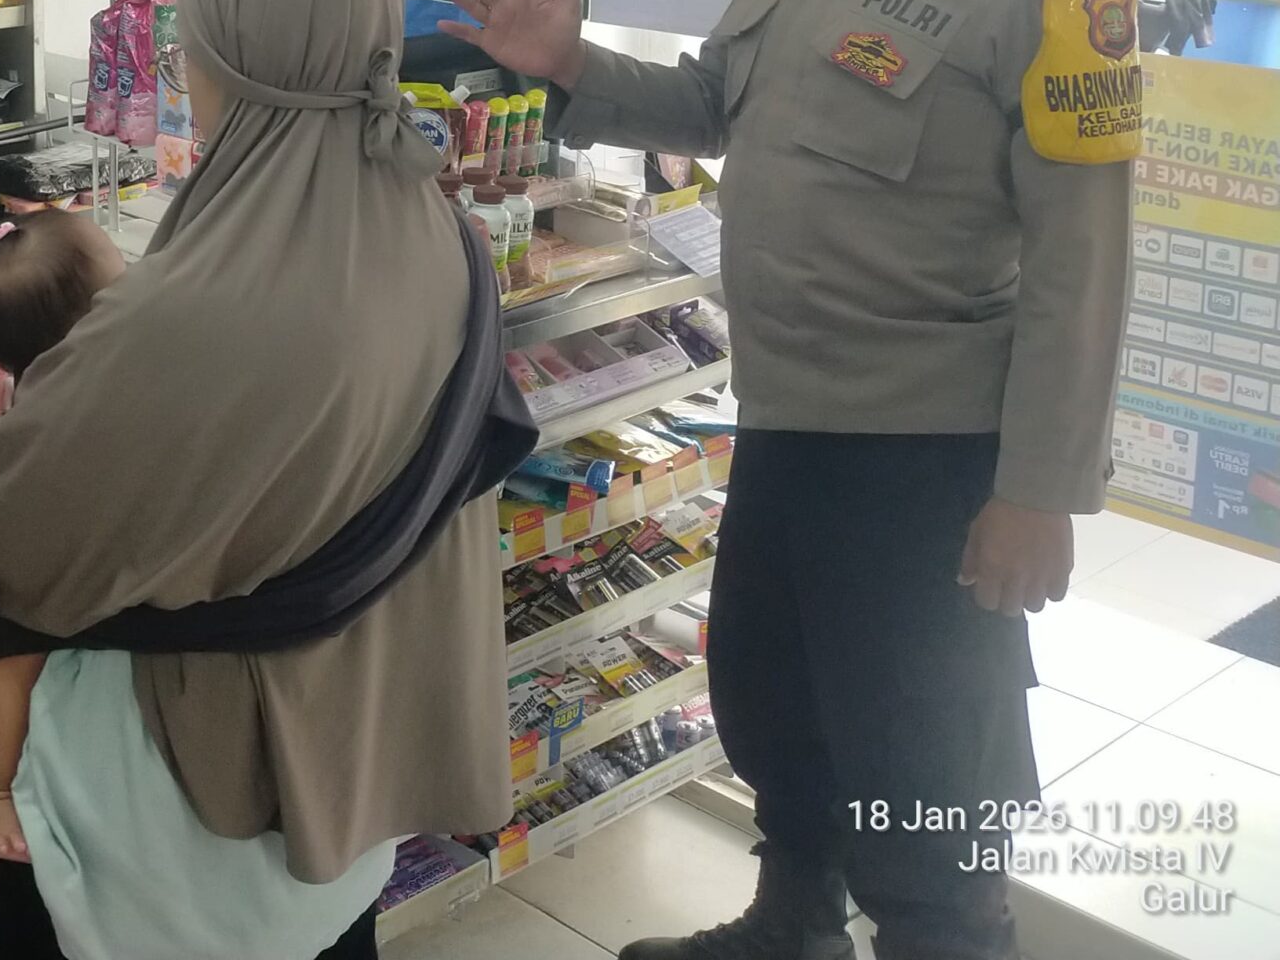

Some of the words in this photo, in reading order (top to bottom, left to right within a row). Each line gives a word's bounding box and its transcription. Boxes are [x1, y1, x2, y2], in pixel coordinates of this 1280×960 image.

[567, 563, 602, 583] Alkaline
[602, 653, 627, 669] POWER
[553, 705, 579, 727] BARU
